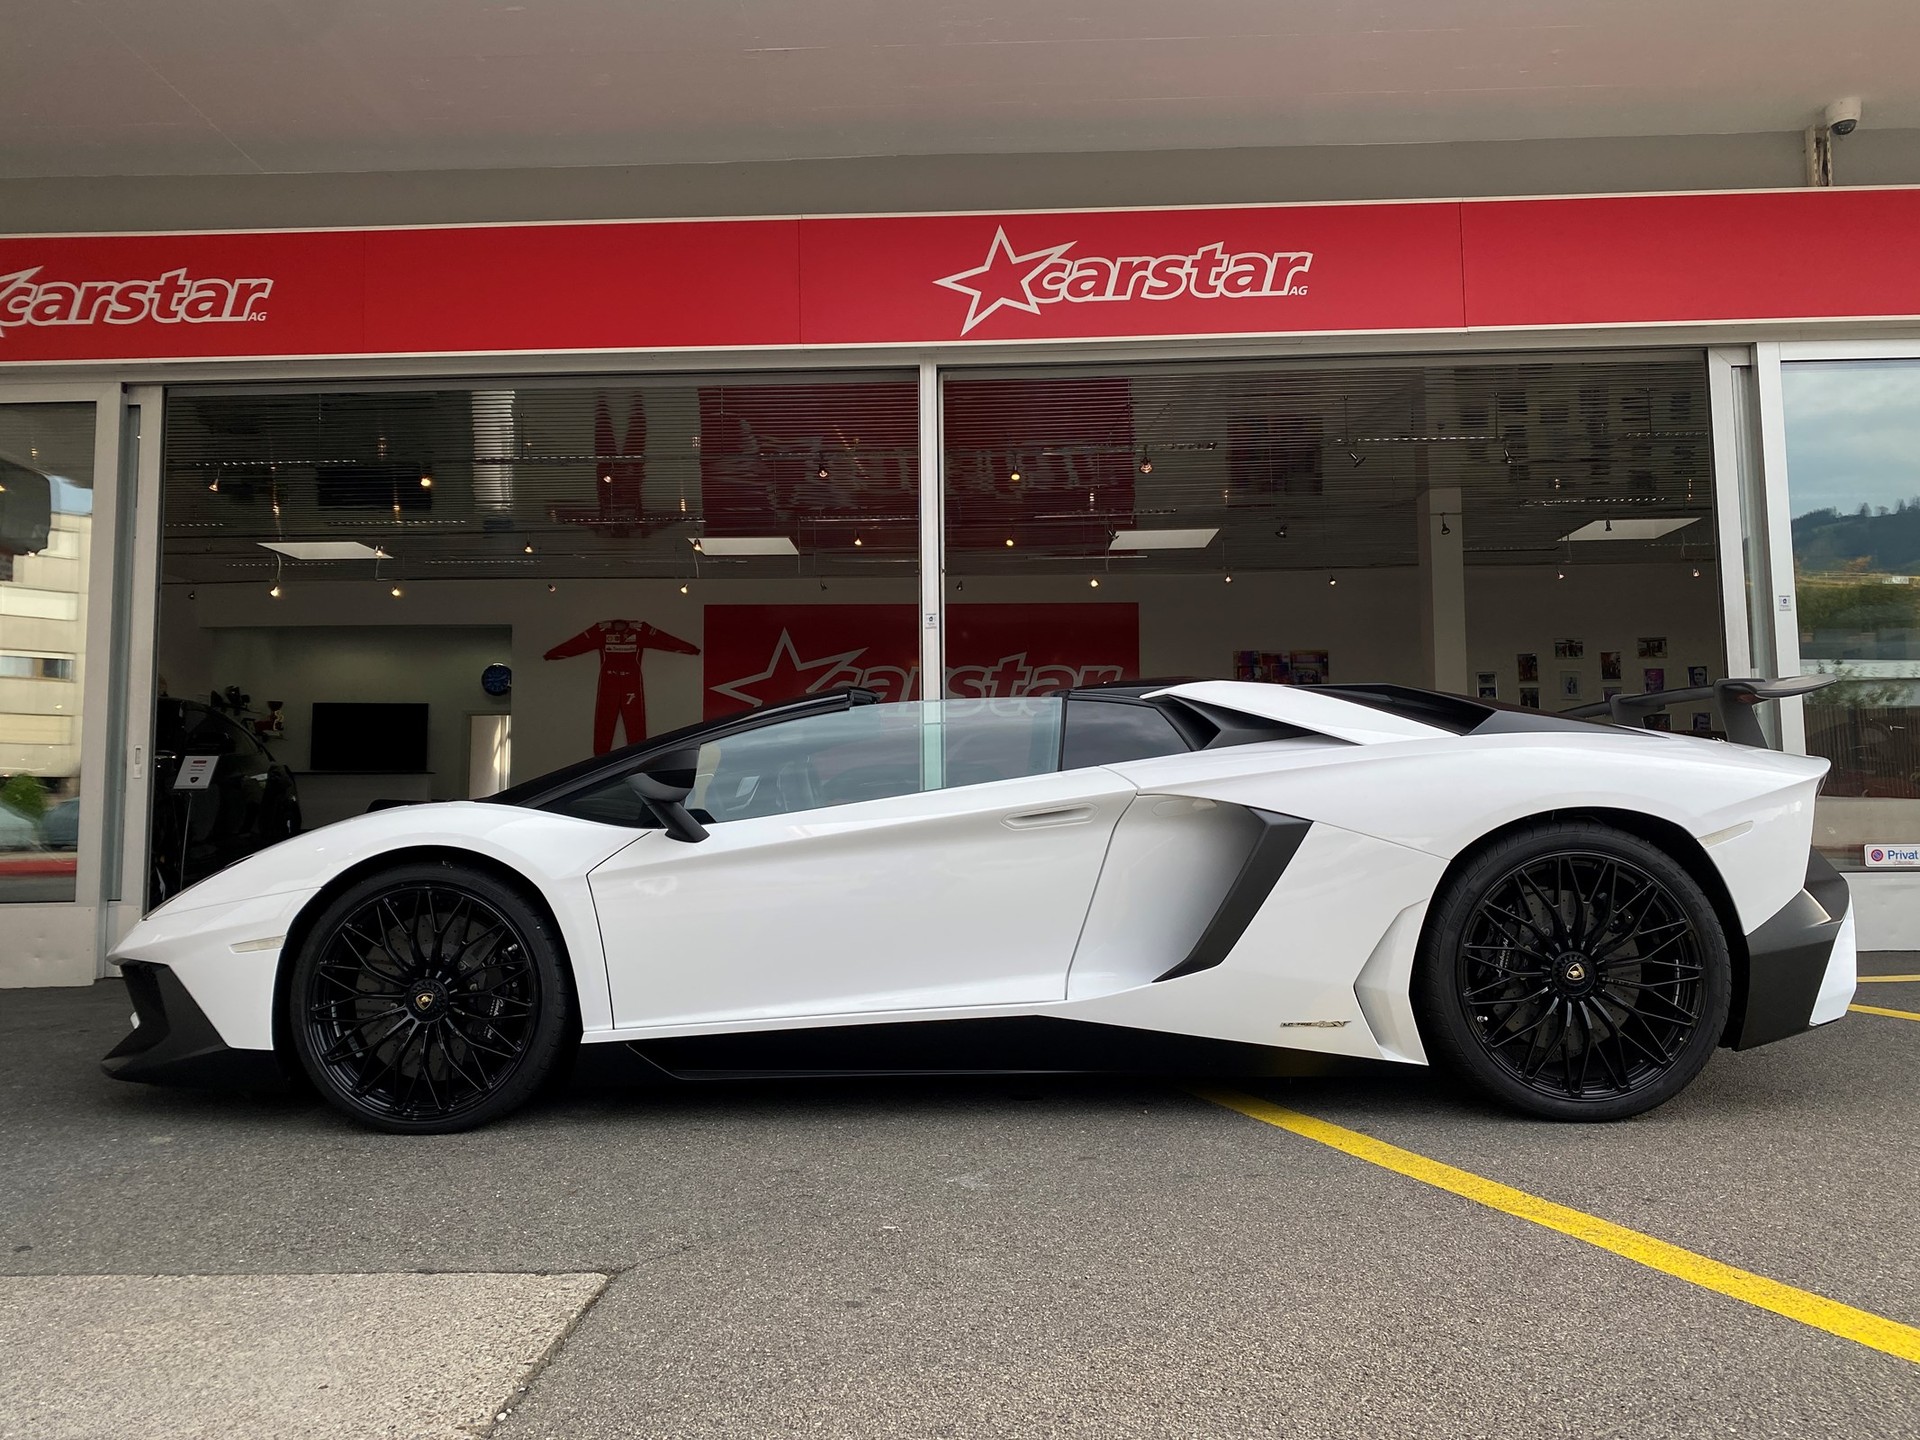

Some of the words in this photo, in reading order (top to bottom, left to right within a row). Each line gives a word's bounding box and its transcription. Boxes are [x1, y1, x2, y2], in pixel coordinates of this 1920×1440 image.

[0, 267, 274, 326] carstar
[248, 311, 268, 322] AG
[1026, 241, 1314, 303] carstar
[1288, 285, 1309, 297] AG
[1887, 850, 1919, 860] Privat
